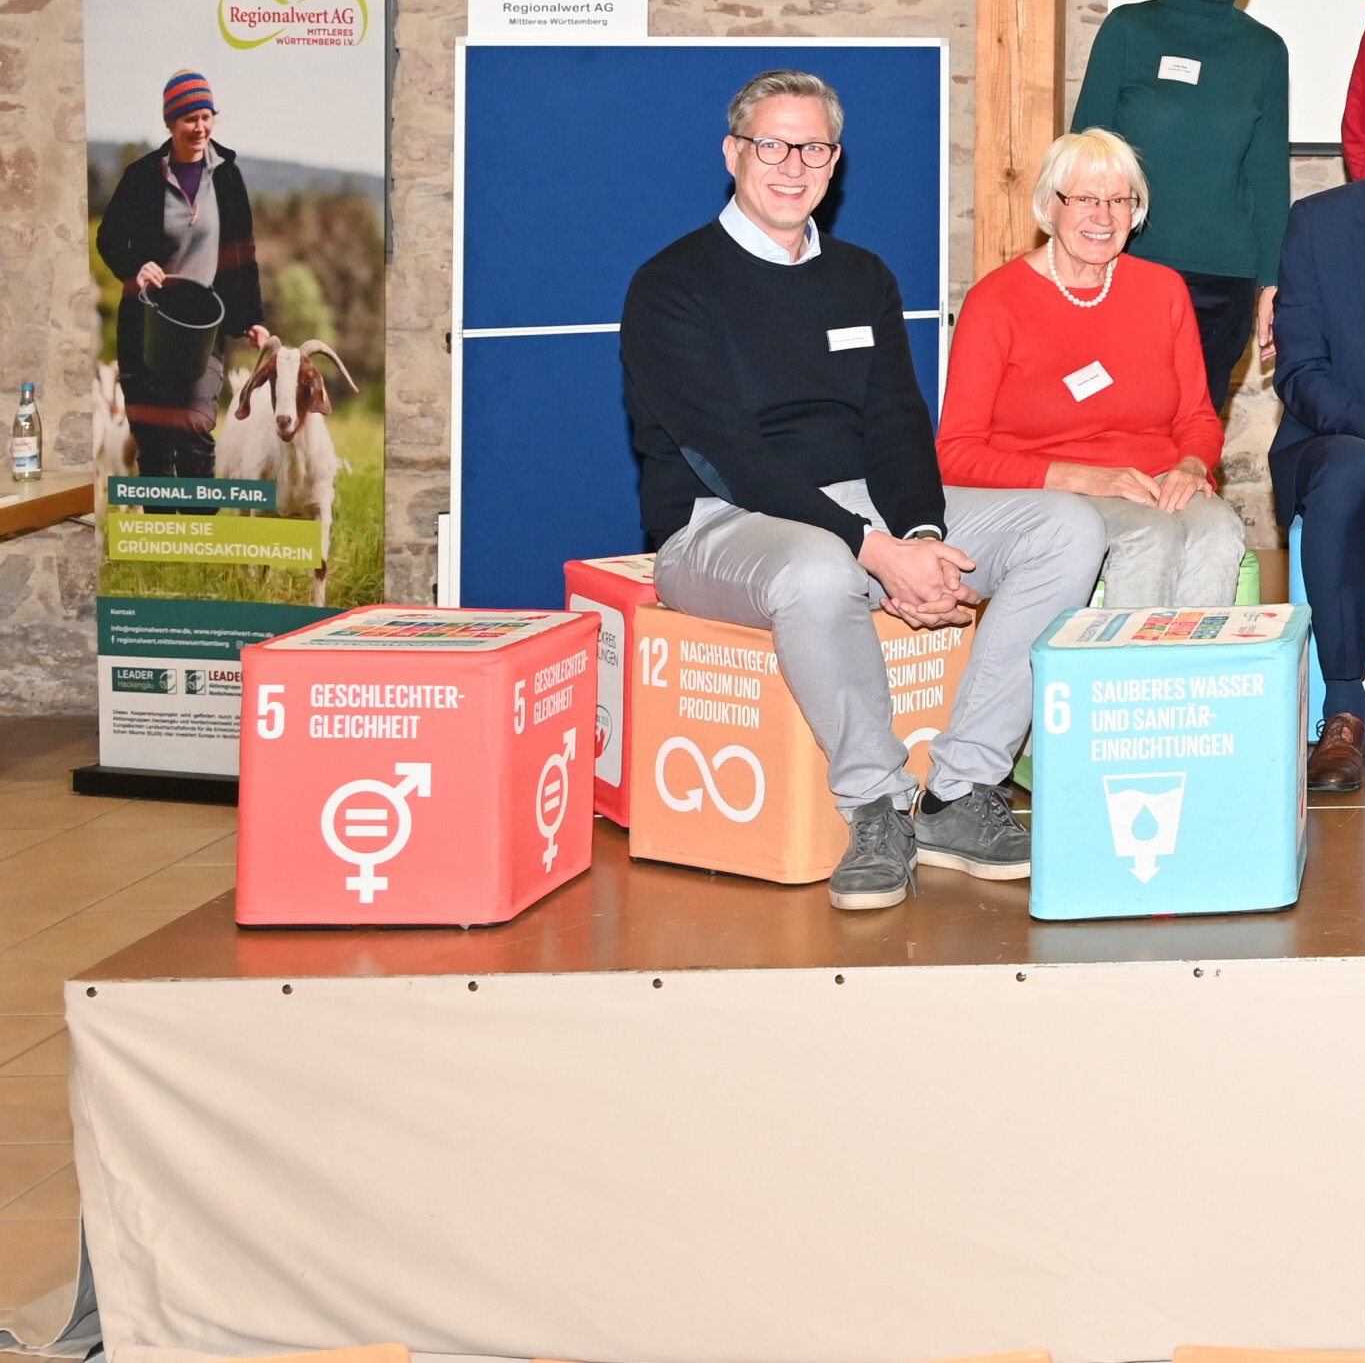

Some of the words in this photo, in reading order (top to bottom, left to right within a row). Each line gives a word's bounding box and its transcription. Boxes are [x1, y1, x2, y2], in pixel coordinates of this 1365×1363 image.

[230, 6, 328, 28] Regionalwert
[331, 8, 354, 25] AG
[503, 3, 590, 14] Regionalwert
[594, 3, 614, 12] AG
[550, 17, 608, 26] Württemberg
[276, 36, 341, 46] WÜRTTEMBERG
[307, 28, 353, 36] MITTLERES
[116, 484, 192, 500] REGIONAL.
[230, 487, 267, 502] FAIR.
[119, 520, 186, 535] WERDEN
[190, 523, 213, 536] SIE
[117, 537, 313, 561] GRÜNDUNGSAKTIONÄR:IN
[680, 640, 778, 675] NACHHALTIGE/R
[881, 627, 963, 662] CHHALTIGE/R
[117, 669, 154, 680] LEADER
[534, 649, 589, 695] GESCHLECHTER-
[639, 636, 668, 688] 12
[919, 658, 944, 681] UND
[208, 670, 242, 683] LEADE
[680, 668, 733, 696] KONSUM
[734, 677, 760, 700] UND
[1092, 678, 1186, 704] SAUBERES
[1189, 673, 1265, 698] WASSER
[310, 683, 465, 709] GESCHLECHTER-
[514, 678, 527, 735] 5
[533, 684, 573, 725] GLEICHHEIT
[1044, 682, 1071, 734] 6
[257, 684, 285, 739] 5
[679, 696, 759, 729] PRODUKTION
[1091, 709, 1129, 733] UND
[1133, 703, 1217, 730] SANITÄR-
[310, 714, 420, 739] GLEICHHEIT
[1091, 733, 1234, 762] EINRICHTUNGEN
